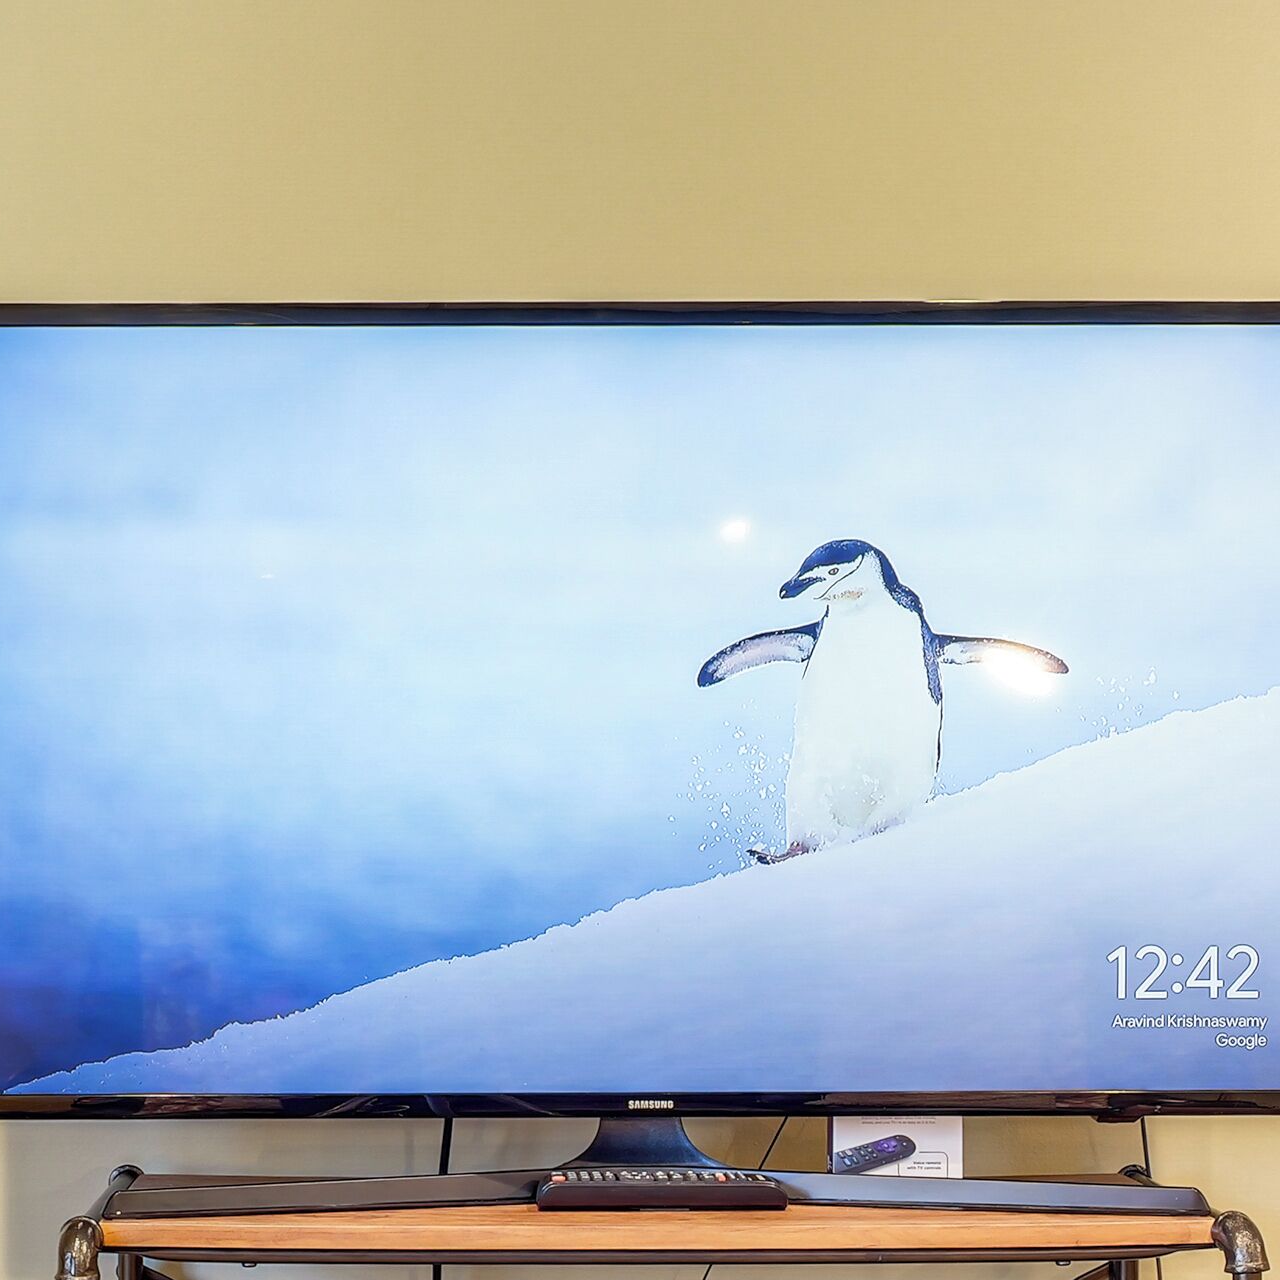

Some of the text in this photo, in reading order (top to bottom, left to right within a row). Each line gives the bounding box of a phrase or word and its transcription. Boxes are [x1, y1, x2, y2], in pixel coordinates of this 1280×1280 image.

[1106, 944, 1260, 1000] 12:42
[1112, 1014, 1267, 1030] Aravind Krishnaswamy
[1215, 1033, 1267, 1050] Google
[628, 1100, 674, 1110] SAMSUNG
